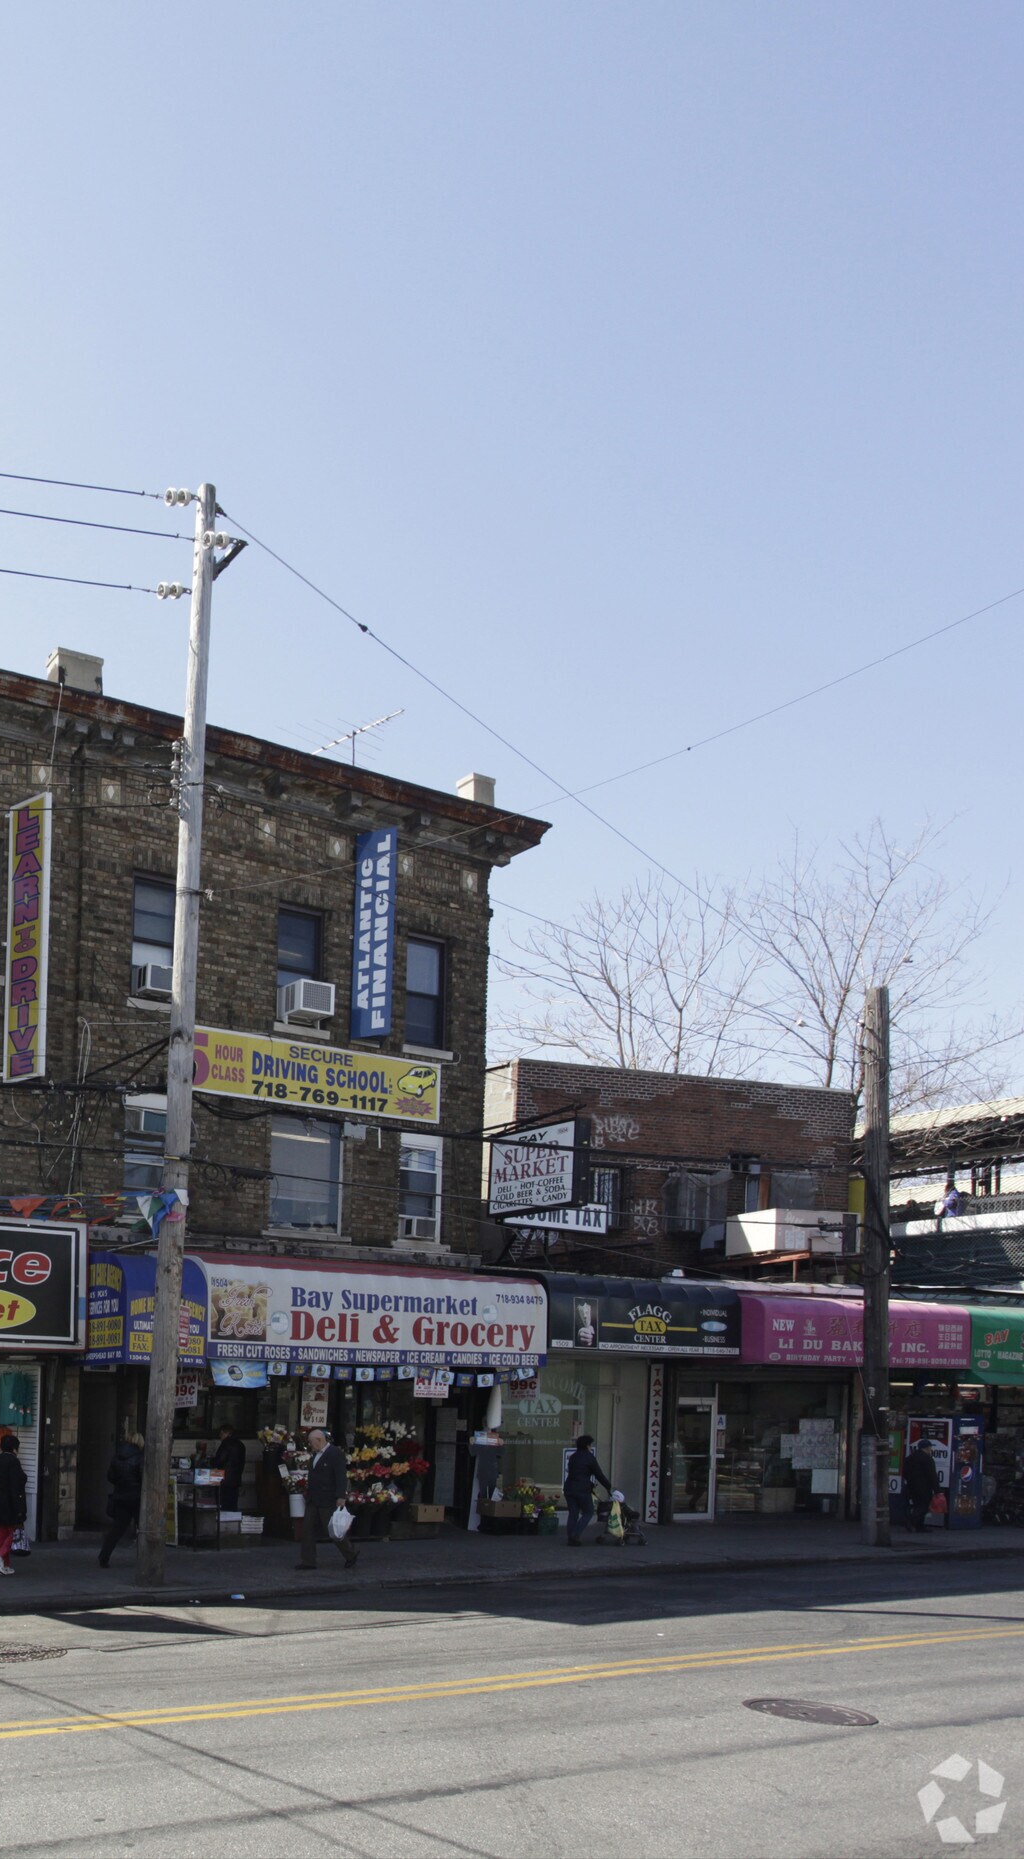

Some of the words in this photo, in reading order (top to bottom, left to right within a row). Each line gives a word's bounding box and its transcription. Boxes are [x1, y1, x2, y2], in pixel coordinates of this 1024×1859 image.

[12, 806, 42, 926] LEARN
[13, 925, 36, 953] TO
[357, 857, 374, 1010] ATLANTIC
[371, 834, 391, 1029] FINANCIAL
[9, 956, 37, 1078] DRIVE
[216, 1044, 243, 1063] HOUR
[289, 1046, 353, 1067] SECURE
[211, 1064, 245, 1084] CLASS
[252, 1050, 319, 1084] DRIVING
[326, 1067, 388, 1094] SCHOOL
[252, 1080, 388, 1112] 718-769-1117
[503, 1140, 559, 1165] SUPER
[494, 1155, 569, 1184] MARKET
[496, 1193, 514, 1201] COLD
[517, 1190, 533, 1198] BEER
[544, 1184, 565, 1194] SODA
[497, 1185, 512, 1194] DELI
[520, 1181, 534, 1190] HOT
[537, 1176, 564, 1187] COFFEE
[542, 1191, 568, 1203] CANDY
[575, 1207, 602, 1228] TAX
[291, 1287, 333, 1311] Bay
[341, 1290, 478, 1316] Supermarket
[628, 1304, 673, 1324] FLAGG
[290, 1310, 359, 1343] Deli
[373, 1314, 400, 1344] &
[412, 1316, 535, 1352] Grocery
[638, 1320, 663, 1332] TAX
[772, 1319, 795, 1332] NEW
[633, 1335, 667, 1344] CENTER
[778, 1338, 794, 1349] LI
[802, 1339, 823, 1350] DU
[901, 1342, 929, 1353] INC.
[984, 1329, 1009, 1346] BAY
[217, 1344, 244, 1356] FRESH
[246, 1346, 263, 1358] CUT
[265, 1346, 290, 1359] ROSES
[298, 1348, 348, 1361] SANDWICHES
[356, 1350, 400, 1363] NEWSPAPER
[407, 1352, 419, 1363] ICE
[420, 1352, 445, 1364] CREAM
[452, 1353, 482, 1364] CANDIES
[489, 1354, 501, 1365] ICE
[502, 1354, 520, 1366] COLD
[521, 1355, 539, 1366] BEER
[824, 1355, 846, 1363] PARTY
[974, 1349, 991, 1358] LOTTO
[653, 1368, 664, 1398] TAX
[526, 1400, 558, 1414] TAX
[517, 1417, 560, 1428] CENTER
[651, 1408, 661, 1438] TAX
[717, 1417, 724, 1426] A
[649, 1449, 659, 1479] TAX
[647, 1490, 657, 1519] TAX
